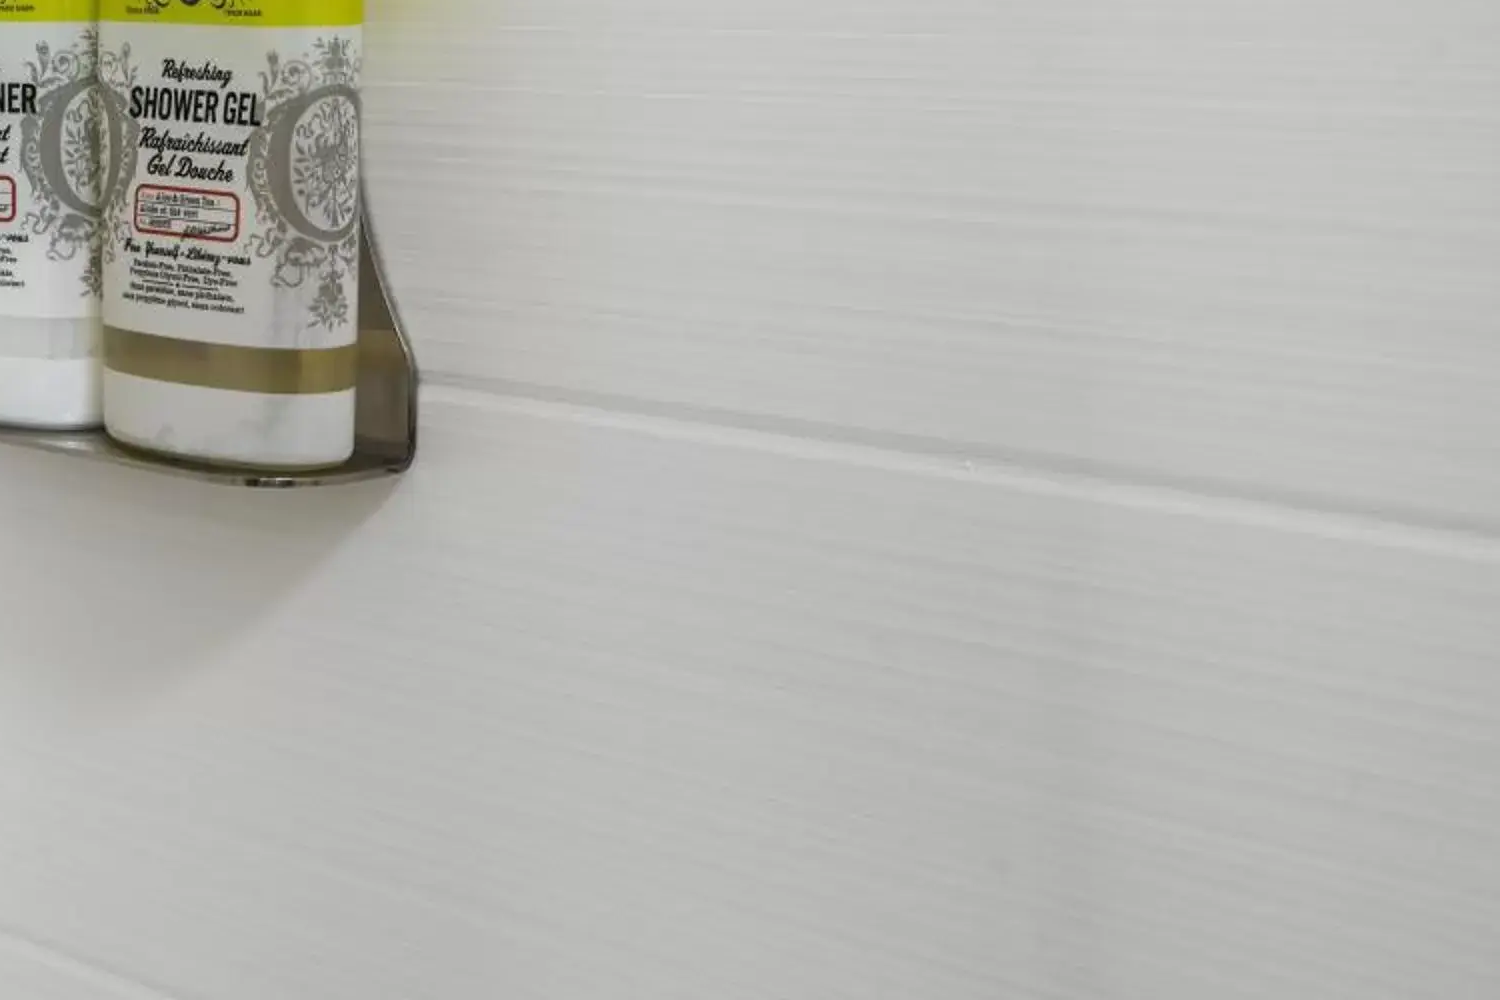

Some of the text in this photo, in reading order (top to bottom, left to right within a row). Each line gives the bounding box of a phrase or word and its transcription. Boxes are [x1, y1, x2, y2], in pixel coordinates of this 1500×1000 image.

[161, 58, 233, 89] Refreshing
[129, 85, 261, 128] SHOWER GEL
[147, 153, 235, 182] Gel Douche
